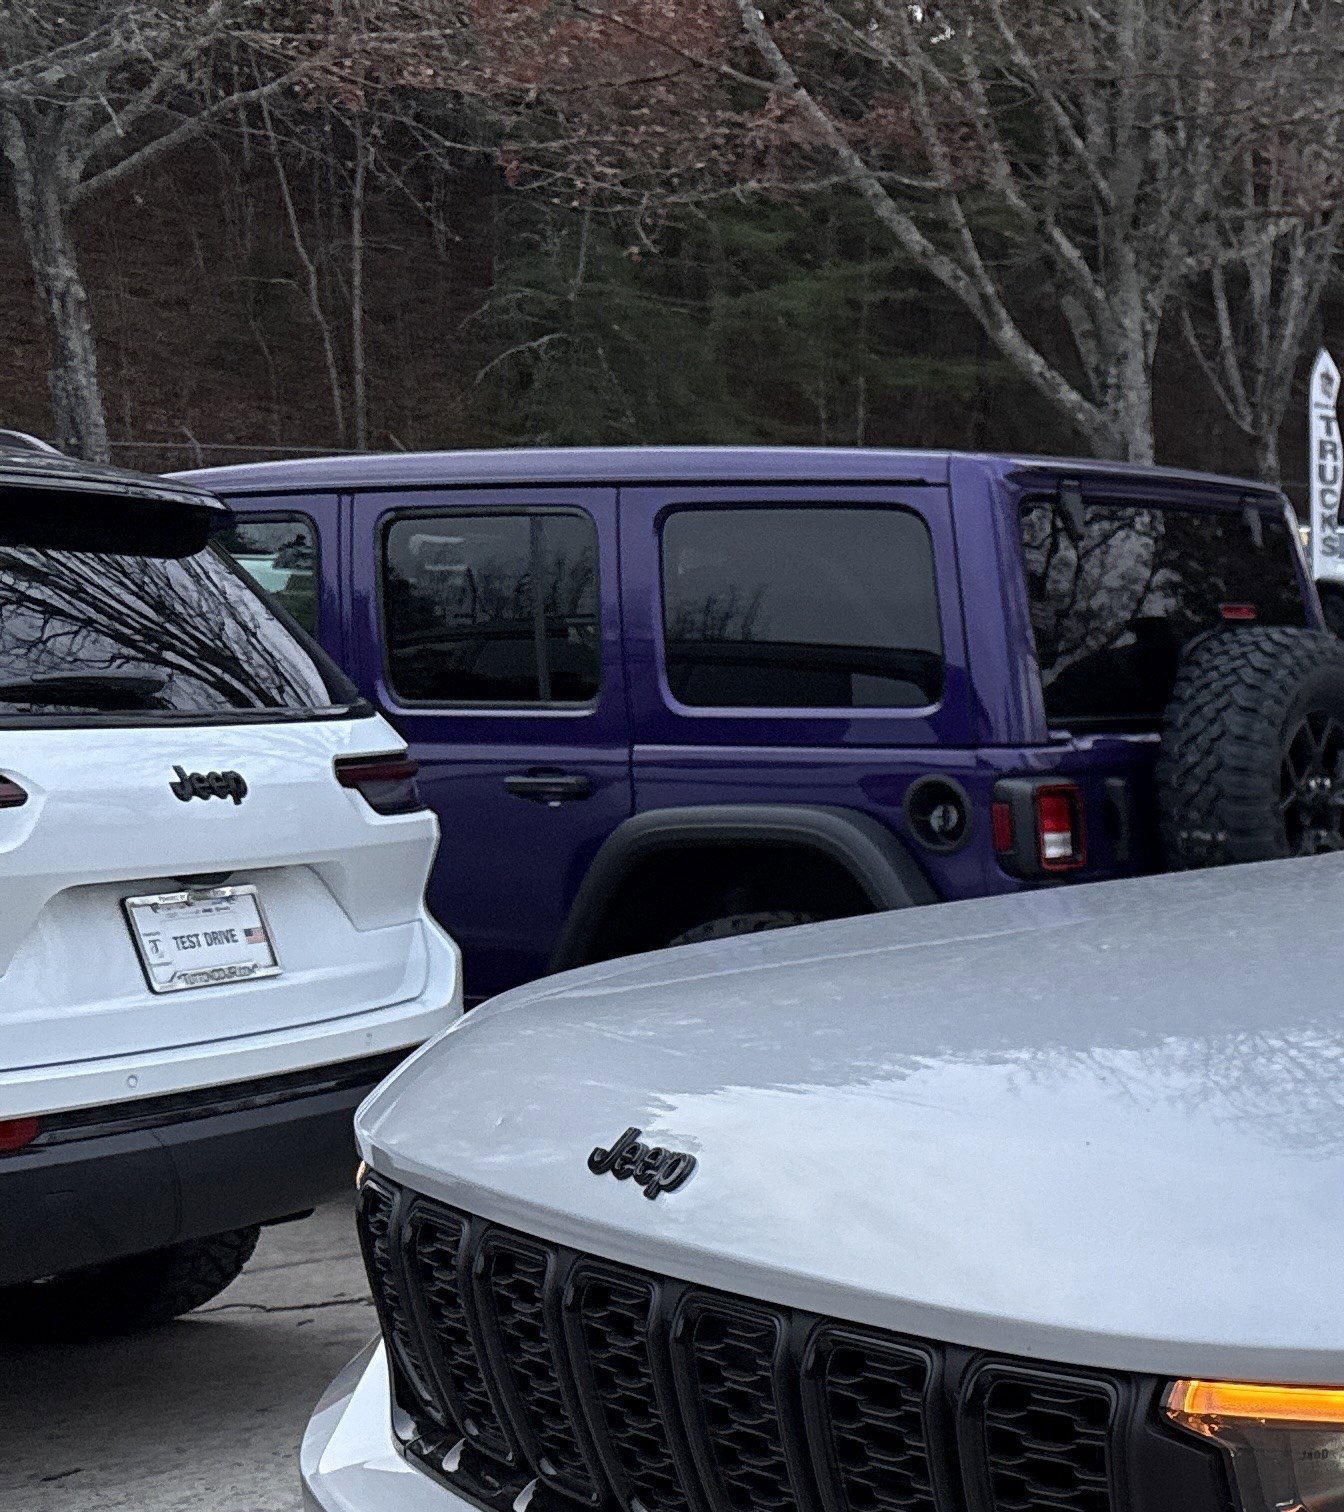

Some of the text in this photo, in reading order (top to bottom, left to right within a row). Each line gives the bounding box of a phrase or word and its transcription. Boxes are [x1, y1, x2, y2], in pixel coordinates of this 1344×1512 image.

[1318, 415, 1340, 557] TRUCKS
[169, 764, 248, 806] Jeep
[172, 934, 201, 951] TEST
[203, 928, 239, 947] DRIVE
[587, 1127, 698, 1201] Jeep
